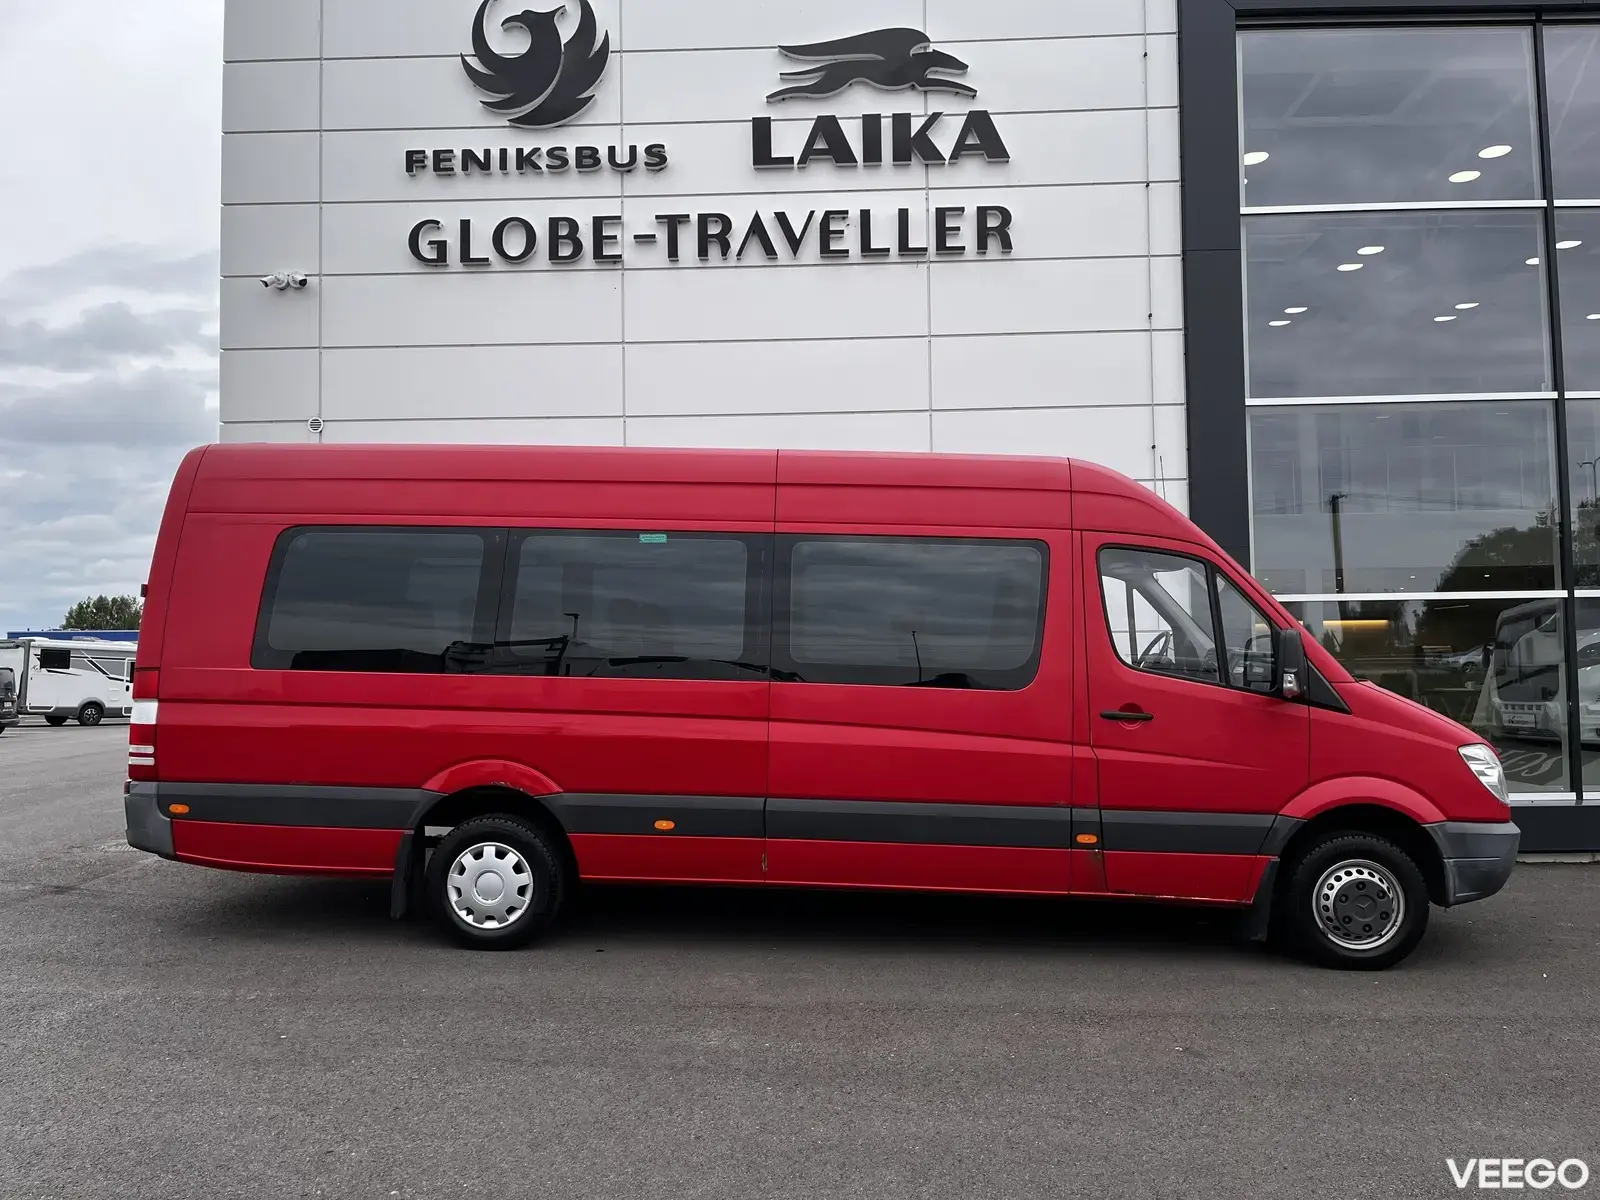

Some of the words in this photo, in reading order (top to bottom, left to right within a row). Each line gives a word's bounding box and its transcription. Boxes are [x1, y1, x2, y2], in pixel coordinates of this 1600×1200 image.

[405, 144, 669, 175] FENIKSBUS
[752, 110, 1010, 169] LAIKA
[408, 205, 1013, 266] GLOBE-TRAVELLER
